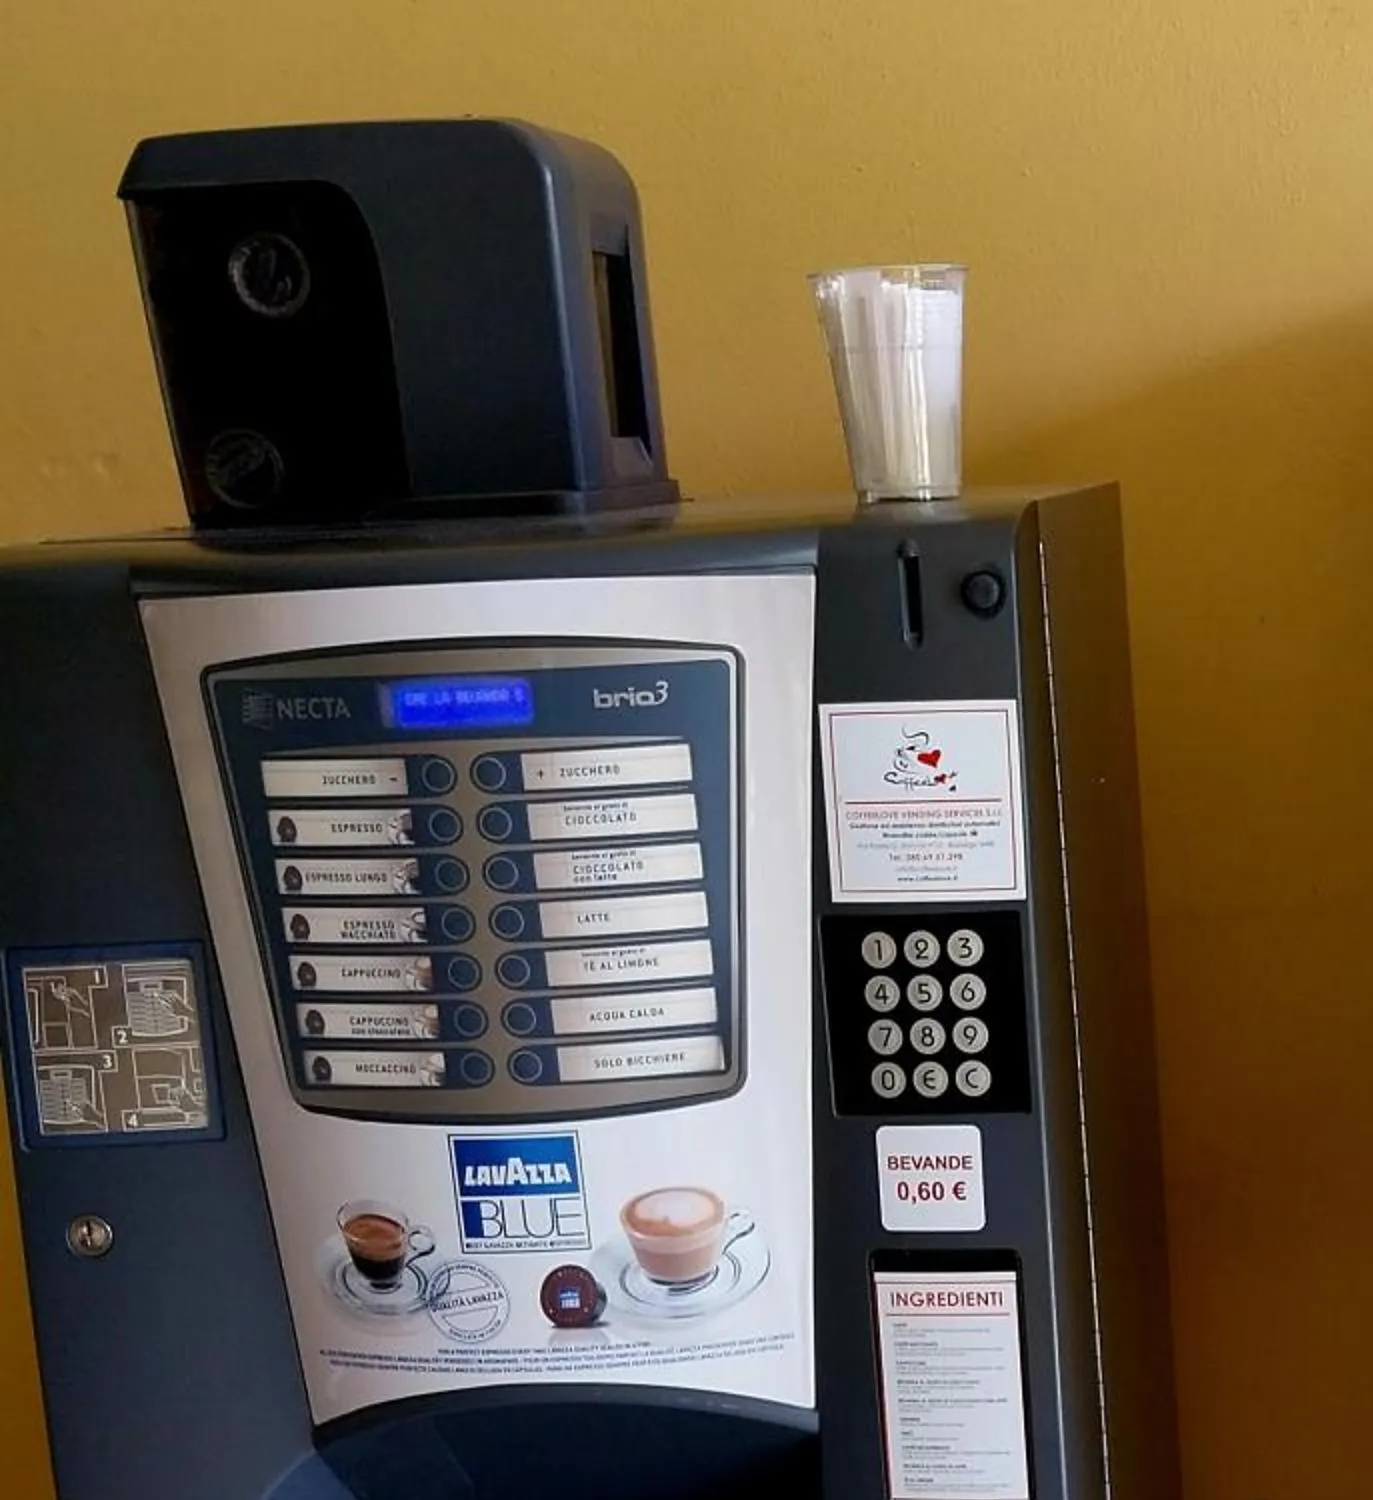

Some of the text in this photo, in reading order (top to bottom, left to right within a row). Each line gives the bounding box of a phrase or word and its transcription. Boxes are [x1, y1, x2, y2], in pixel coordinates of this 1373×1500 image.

[276, 697, 352, 721] NECTA
[559, 764, 621, 778] ZUCCHERO
[565, 813, 637, 827] CIOCCOLATO
[330, 822, 383, 834] ESPRESSO
[573, 861, 644, 875] CIOCCOLATO
[305, 870, 388, 883] ESPRESSO LUNGO
[343, 919, 395, 930] ESPRESSO
[577, 913, 610, 924] LATTE
[874, 937, 973, 961] 1 2 3
[600, 960, 613, 971] AL
[617, 957, 659, 969] LIMONE
[341, 968, 401, 978] CAPPUCCINO
[874, 981, 975, 1005] 4 5 6
[349, 1016, 409, 1027] CAPPUCCINO
[589, 1007, 664, 1022] ACQUA CALDA
[117, 1029, 128, 1044] 2
[879, 1024, 978, 1048] 7 8 9
[103, 1055, 112, 1069] 3
[594, 1053, 685, 1069] SOLO BICCHIERE
[881, 1069, 895, 1091] 0
[965, 1067, 979, 1089] C
[127, 1113, 138, 1128] 4
[887, 1155, 973, 1171] BEVANDE
[464, 1157, 573, 1187] LAVAZZA
[896, 1181, 967, 1205] 0,60 €
[460, 1198, 585, 1239] BLUE
[890, 1291, 1004, 1308] INGREDIENTI
